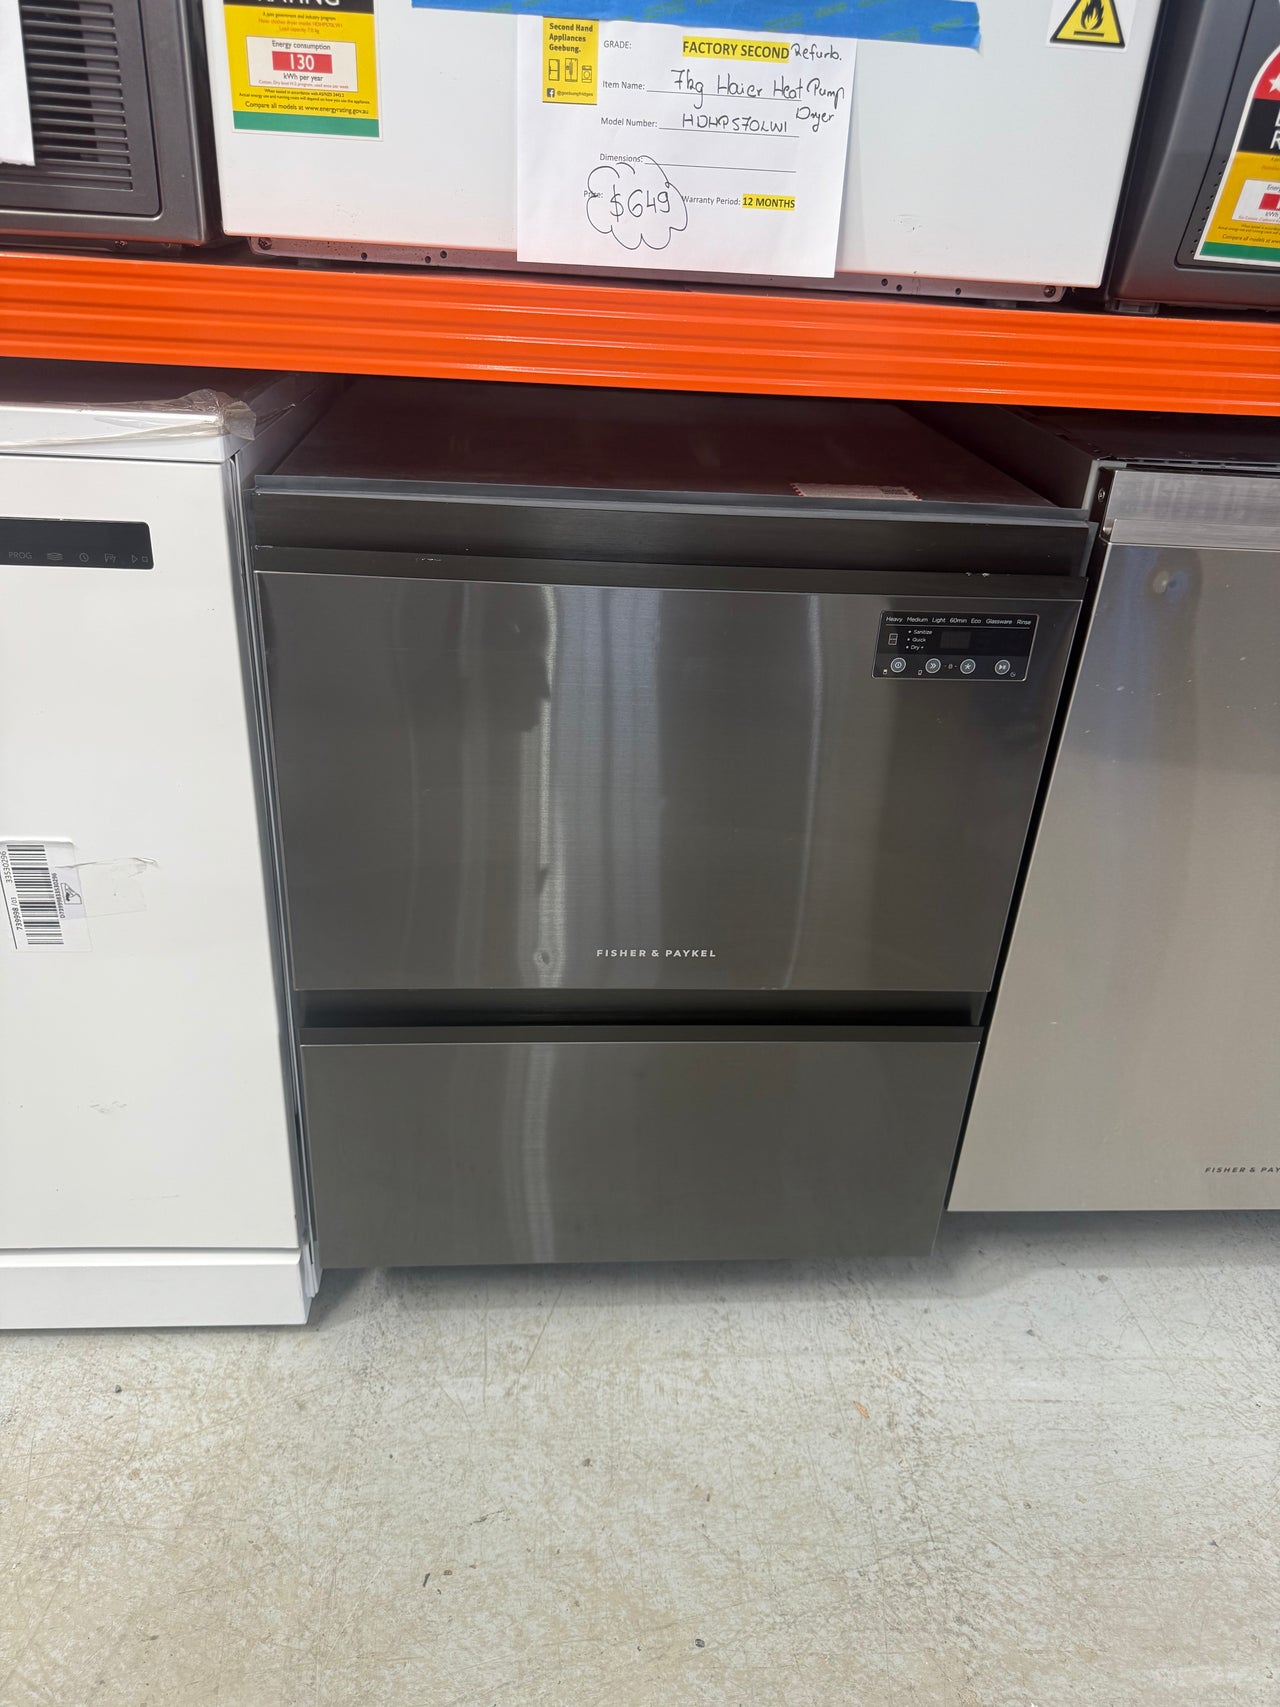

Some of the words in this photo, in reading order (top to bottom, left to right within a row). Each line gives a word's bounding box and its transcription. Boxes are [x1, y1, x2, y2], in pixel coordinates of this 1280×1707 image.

[549, 22, 575, 31] Second
[576, 24, 593, 32] Hand
[549, 33, 586, 42] Appliances
[272, 40, 292, 50] Energy
[293, 42, 331, 51] consumption
[549, 44, 581, 54] Geebung.
[603, 40, 632, 50] GRADE:
[683, 41, 738, 56] FACTORY
[740, 44, 789, 60] SECOND
[791, 43, 842, 61] Refurb.
[290, 53, 315, 71] 130
[602, 81, 620, 89] Item
[621, 82, 646, 90] Name:
[671, 69, 704, 109] 7kg
[717, 73, 763, 98] Haier
[773, 75, 803, 100] Heat
[806, 78, 845, 110] Pump
[245, 101, 270, 109] Compare
[305, 106, 369, 115] www.energyrating.gov.au
[601, 117, 624, 126] Model
[626, 119, 658, 128] Number:
[796, 106, 835, 133] Dryer
[599, 153, 643, 163] Dimensions:
[610, 184, 670, 223] $649
[682, 195, 715, 206] Warranty
[716, 197, 741, 207] Period:
[742, 197, 753, 207] 12
[755, 198, 796, 209] MONTHS
[8, 551, 33, 560] PROG
[0, 850, 13, 884] 33530296
[11, 907, 23, 931] 739998
[596, 949, 647, 957] FISHER
[651, 949, 660, 957] &
[665, 949, 716, 957] PAYKEL
